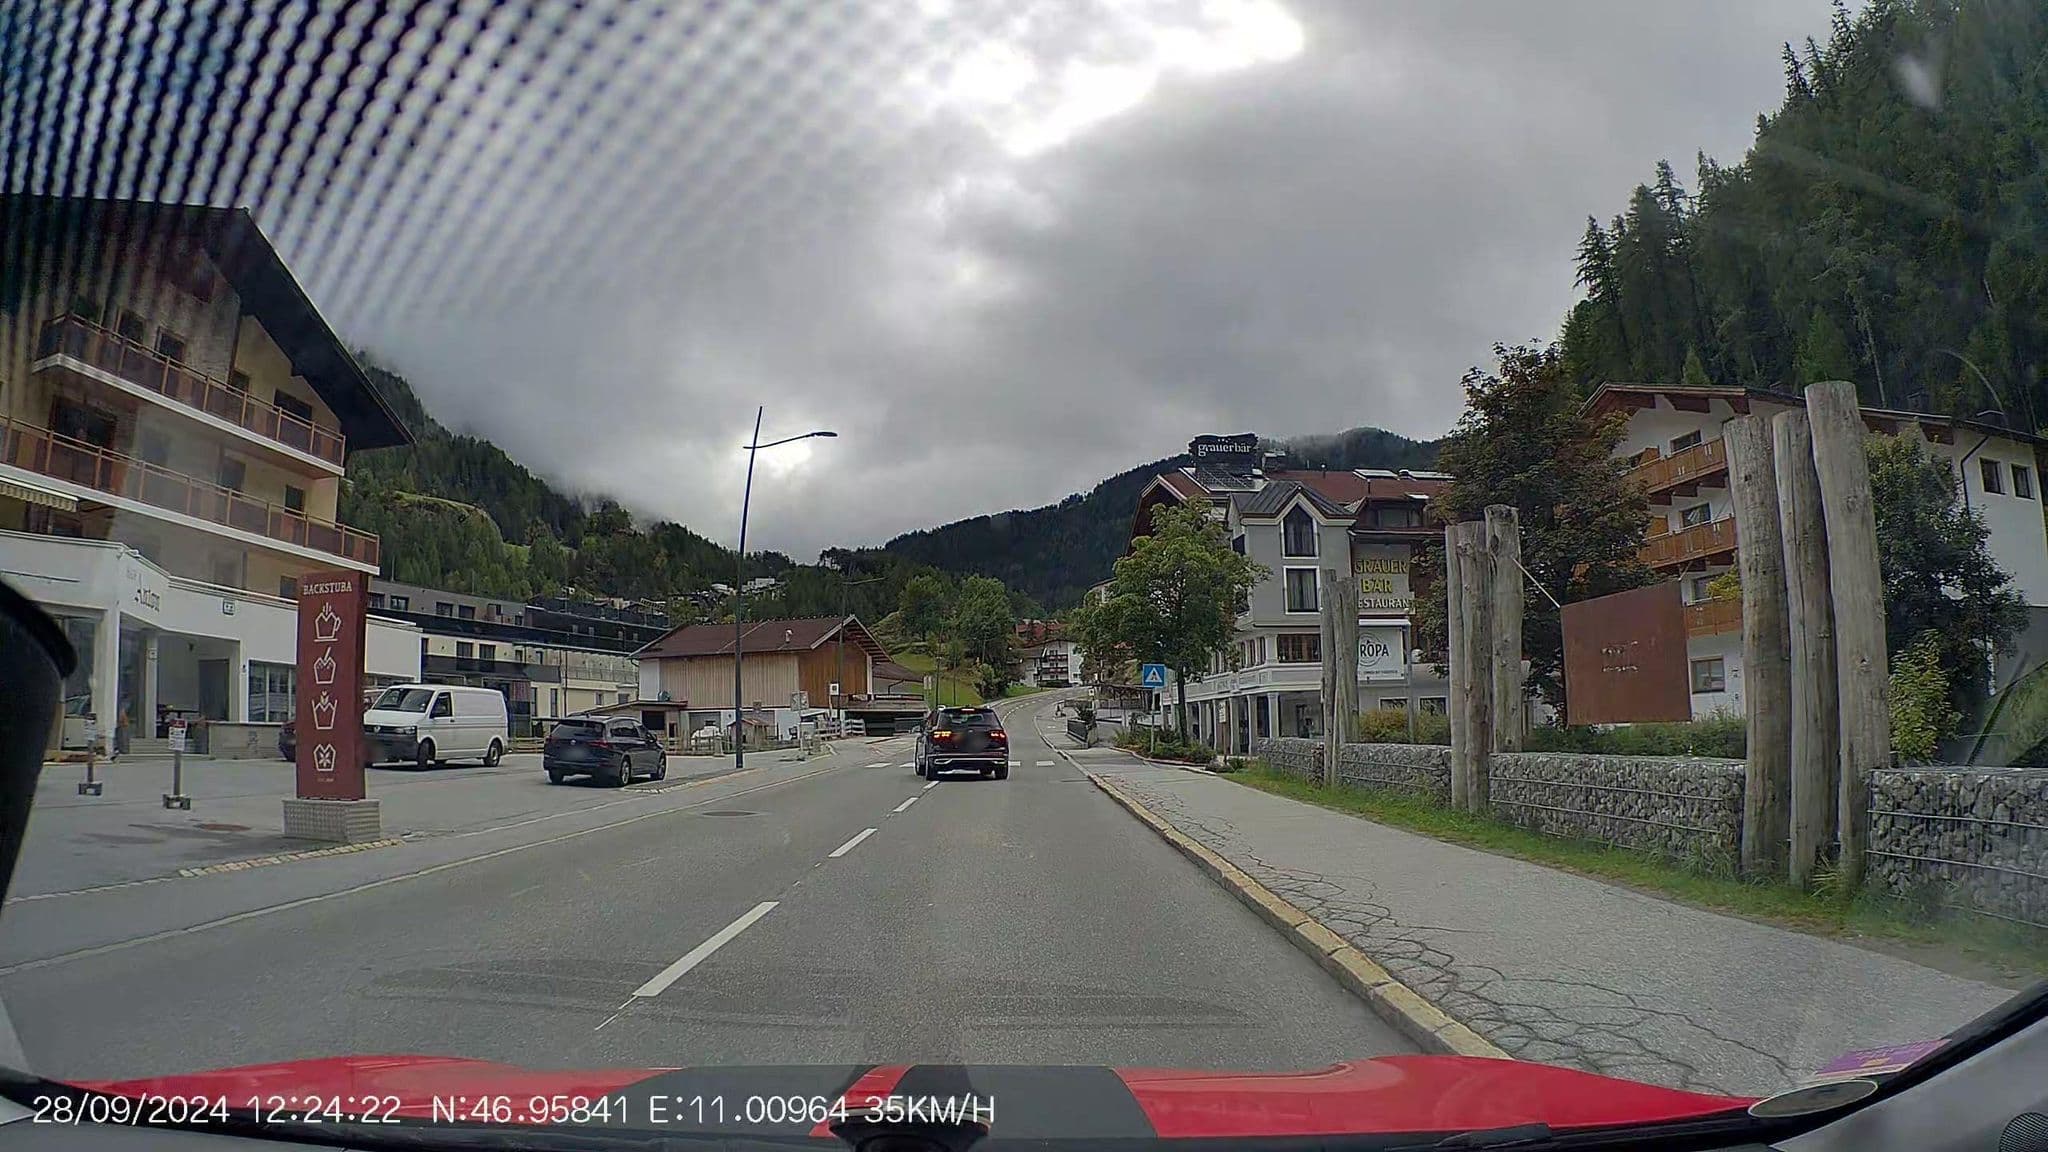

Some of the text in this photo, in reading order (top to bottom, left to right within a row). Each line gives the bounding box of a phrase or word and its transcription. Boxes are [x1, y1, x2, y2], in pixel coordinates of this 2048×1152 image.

[1198, 442, 1252, 457] grauerbär
[1354, 559, 1408, 574] GRAUER
[303, 581, 353, 596] BACKSTUBA
[1357, 598, 1409, 609] ESTAURAN
[1359, 643, 1390, 657] ROPA
